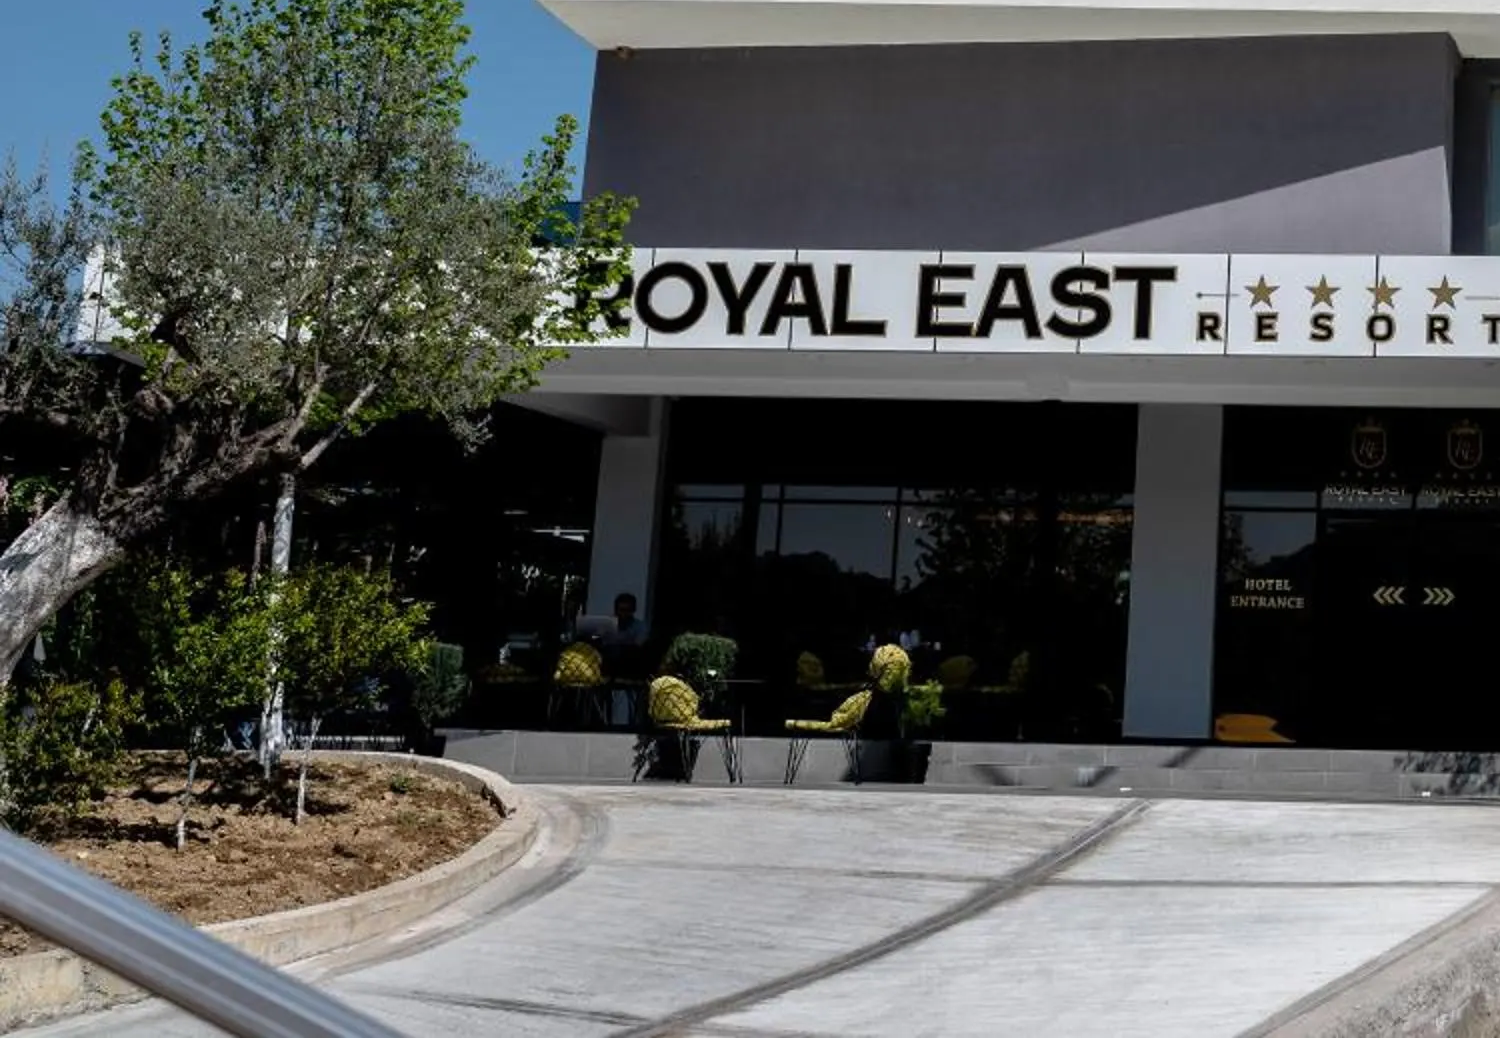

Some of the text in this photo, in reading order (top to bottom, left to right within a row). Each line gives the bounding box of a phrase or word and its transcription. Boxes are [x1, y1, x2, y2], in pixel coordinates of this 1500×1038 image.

[914, 263, 1178, 340] EAST
[1244, 578, 1292, 592] HOTEL
[1230, 595, 1305, 610] ENTRANCE
